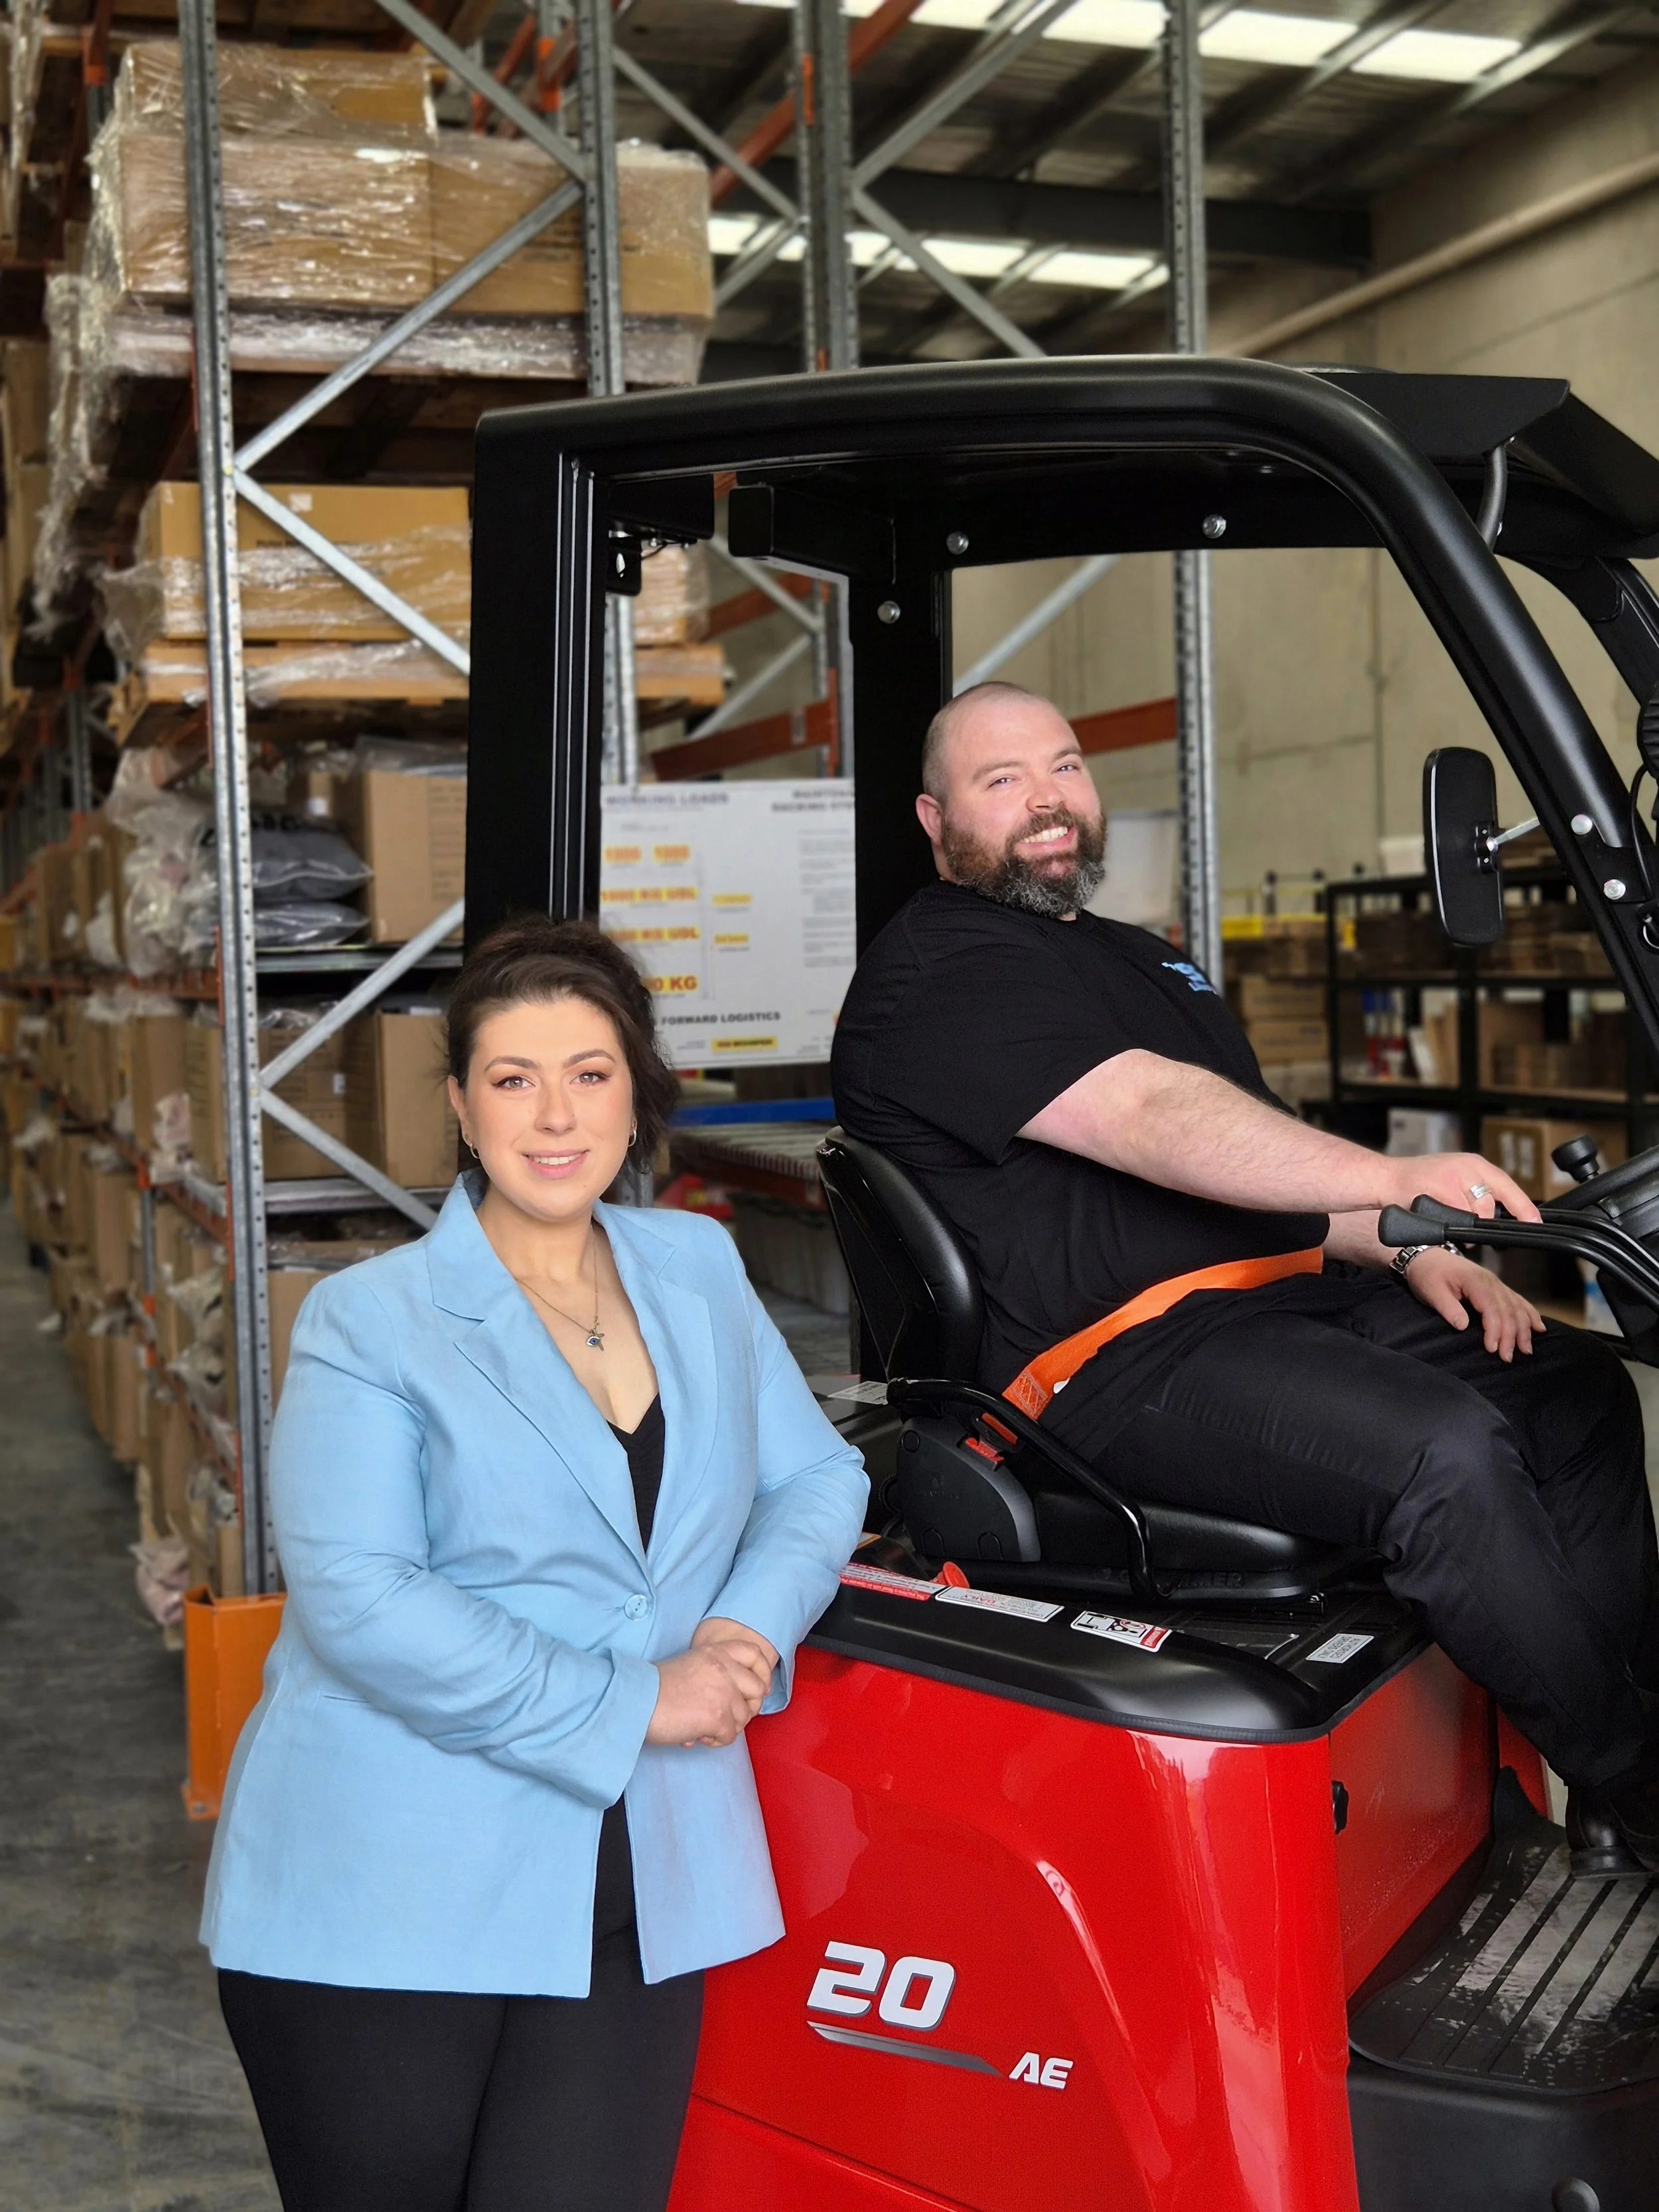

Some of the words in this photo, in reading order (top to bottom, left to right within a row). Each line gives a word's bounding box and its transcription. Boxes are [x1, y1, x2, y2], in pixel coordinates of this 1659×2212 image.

[670, 976, 697, 990] KG
[662, 1014, 719, 1025] FORWARD
[721, 1011, 781, 1023] LOGISTICS
[961, 1595, 997, 1605] DAILY
[807, 1941, 956, 2031] 20
[1009, 2052, 1074, 2089] AE
